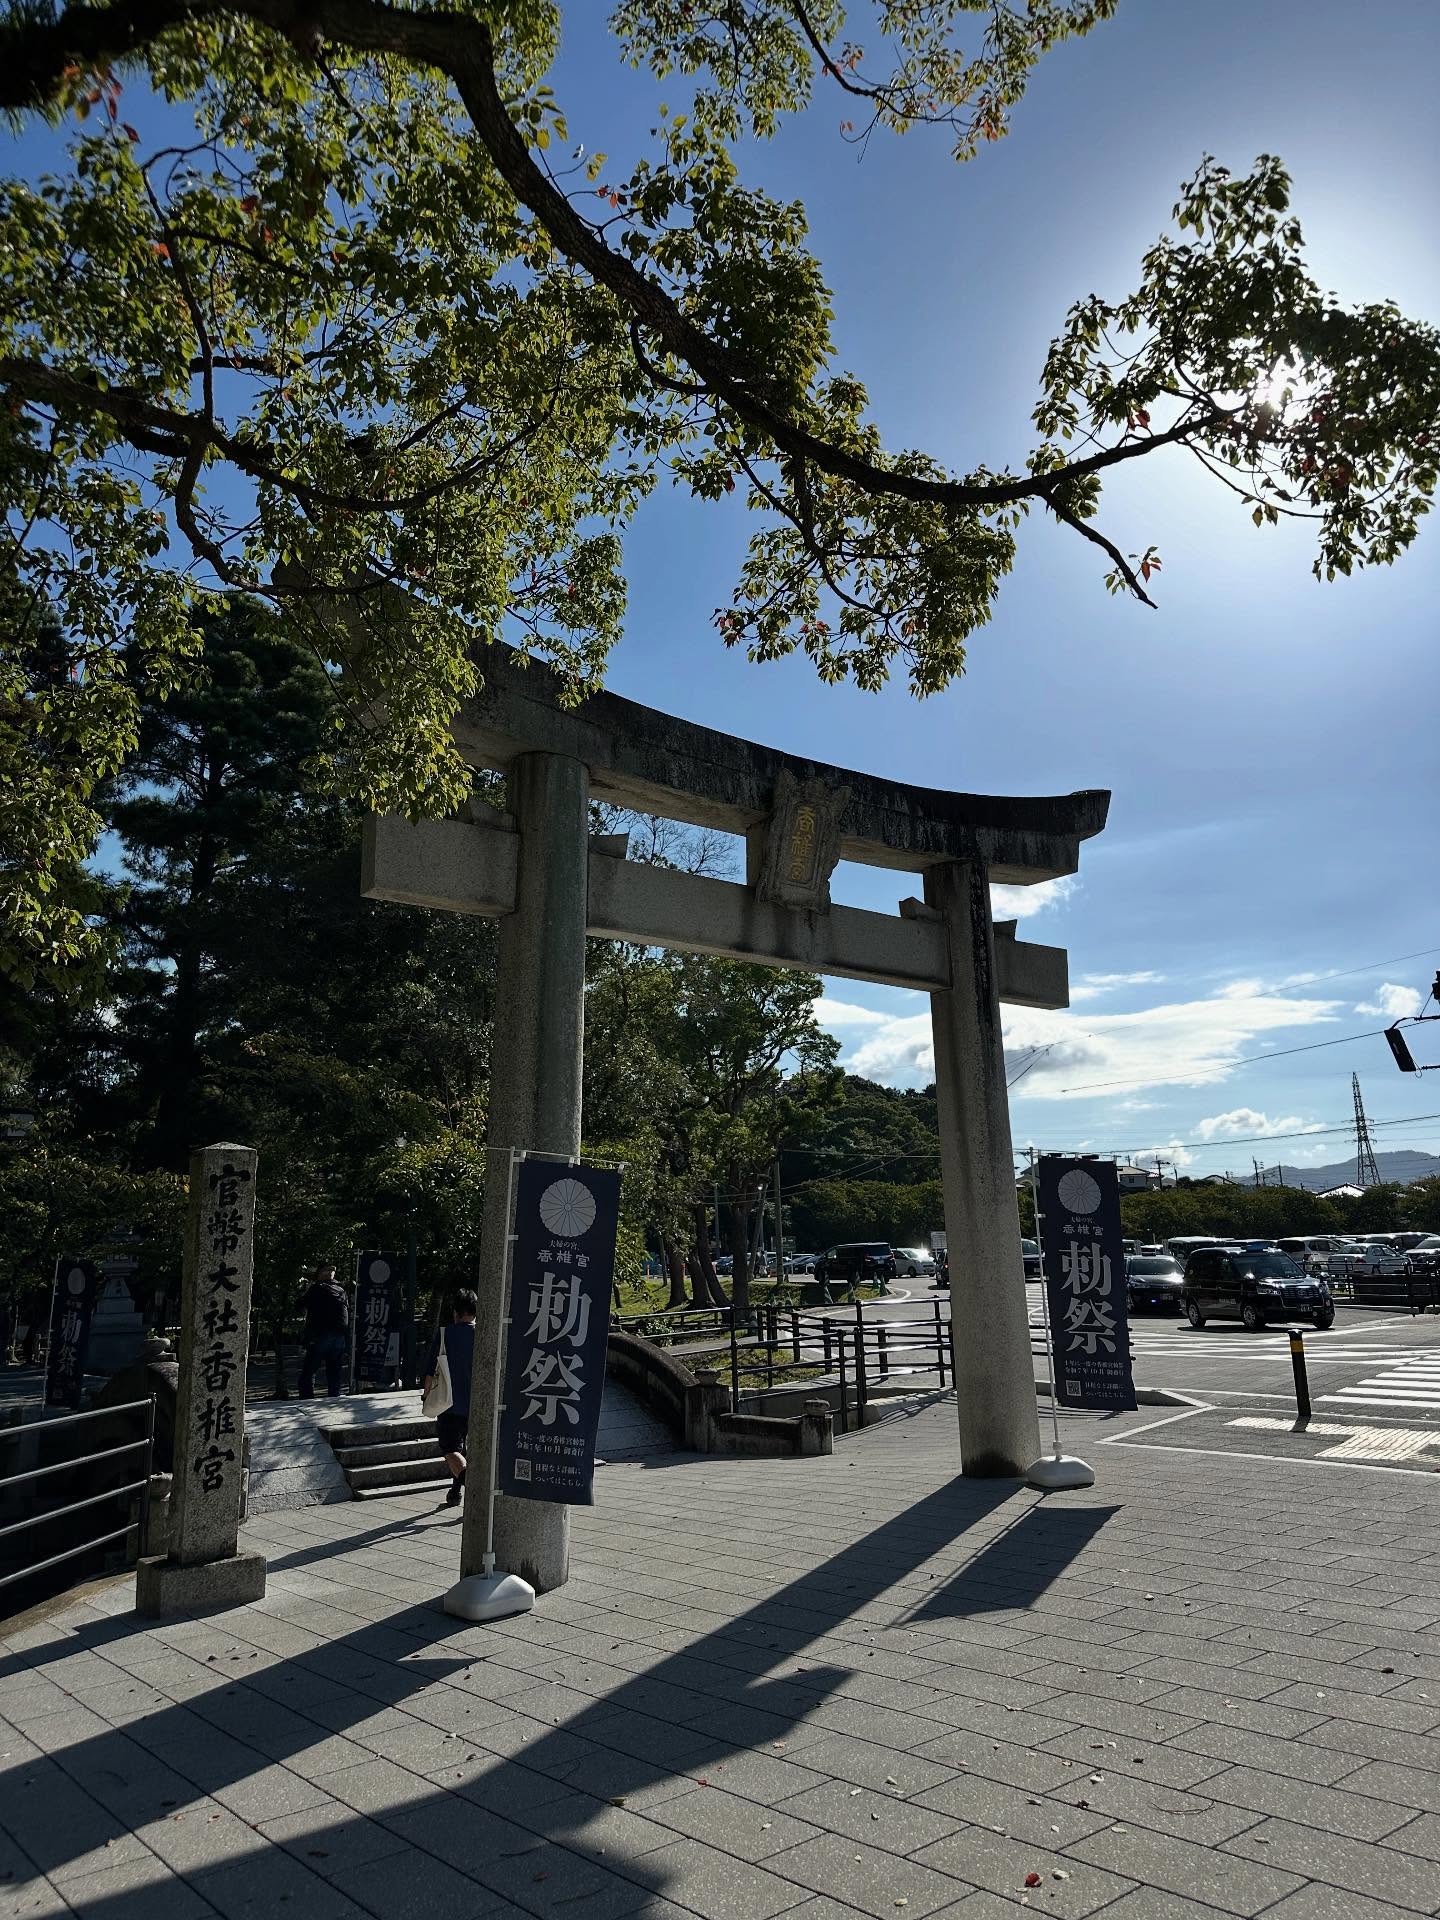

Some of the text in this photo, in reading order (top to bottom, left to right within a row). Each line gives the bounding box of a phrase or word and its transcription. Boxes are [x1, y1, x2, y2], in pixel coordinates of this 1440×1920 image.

[537, 1249, 590, 1268] 香椎宮
[1062, 1224, 1104, 1236] 香椎宮
[193, 1163, 250, 1494] 官幣大社香椎宮
[364, 1297, 390, 1355] 勅祭
[1059, 1240, 1118, 1353] 勅祭
[519, 1271, 593, 1426] 勅祭
